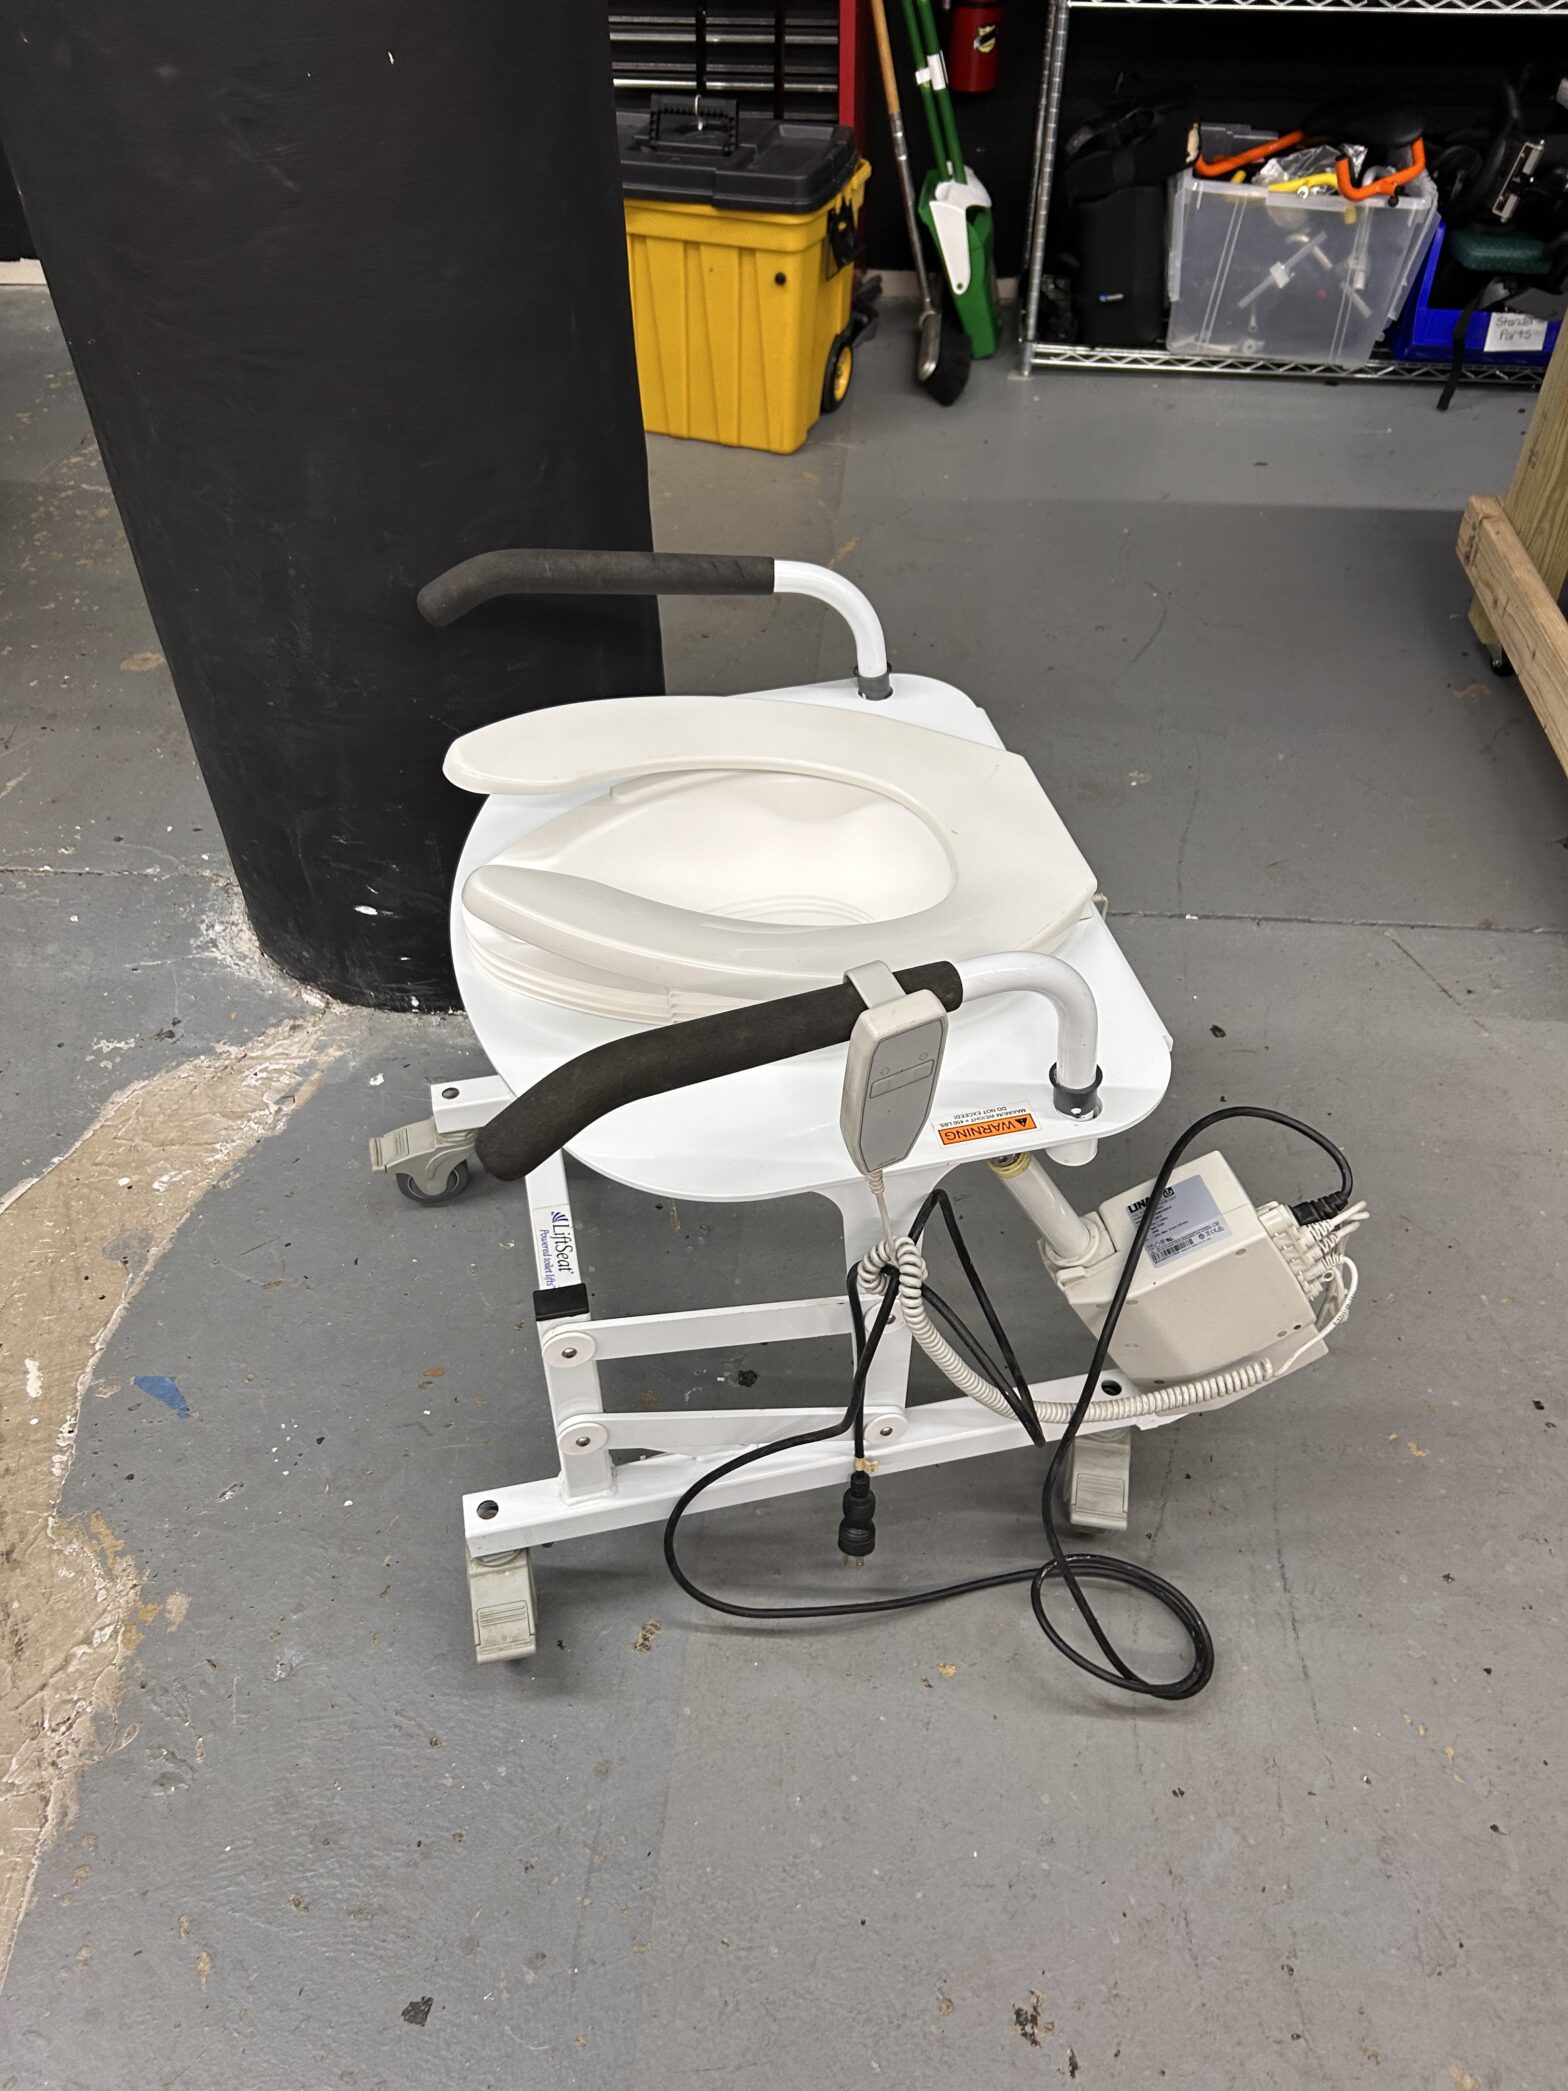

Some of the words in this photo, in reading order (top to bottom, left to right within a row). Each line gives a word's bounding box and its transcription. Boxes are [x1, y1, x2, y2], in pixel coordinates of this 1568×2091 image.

[1500, 328, 1532, 340] Parts
[971, 1114, 995, 1122] WEIGHT
[996, 1108, 1026, 1118] MAXIMUM
[945, 1120, 1016, 1141] WARNING
[540, 1230, 552, 1257] Powered
[543, 1258, 555, 1274] toilet
